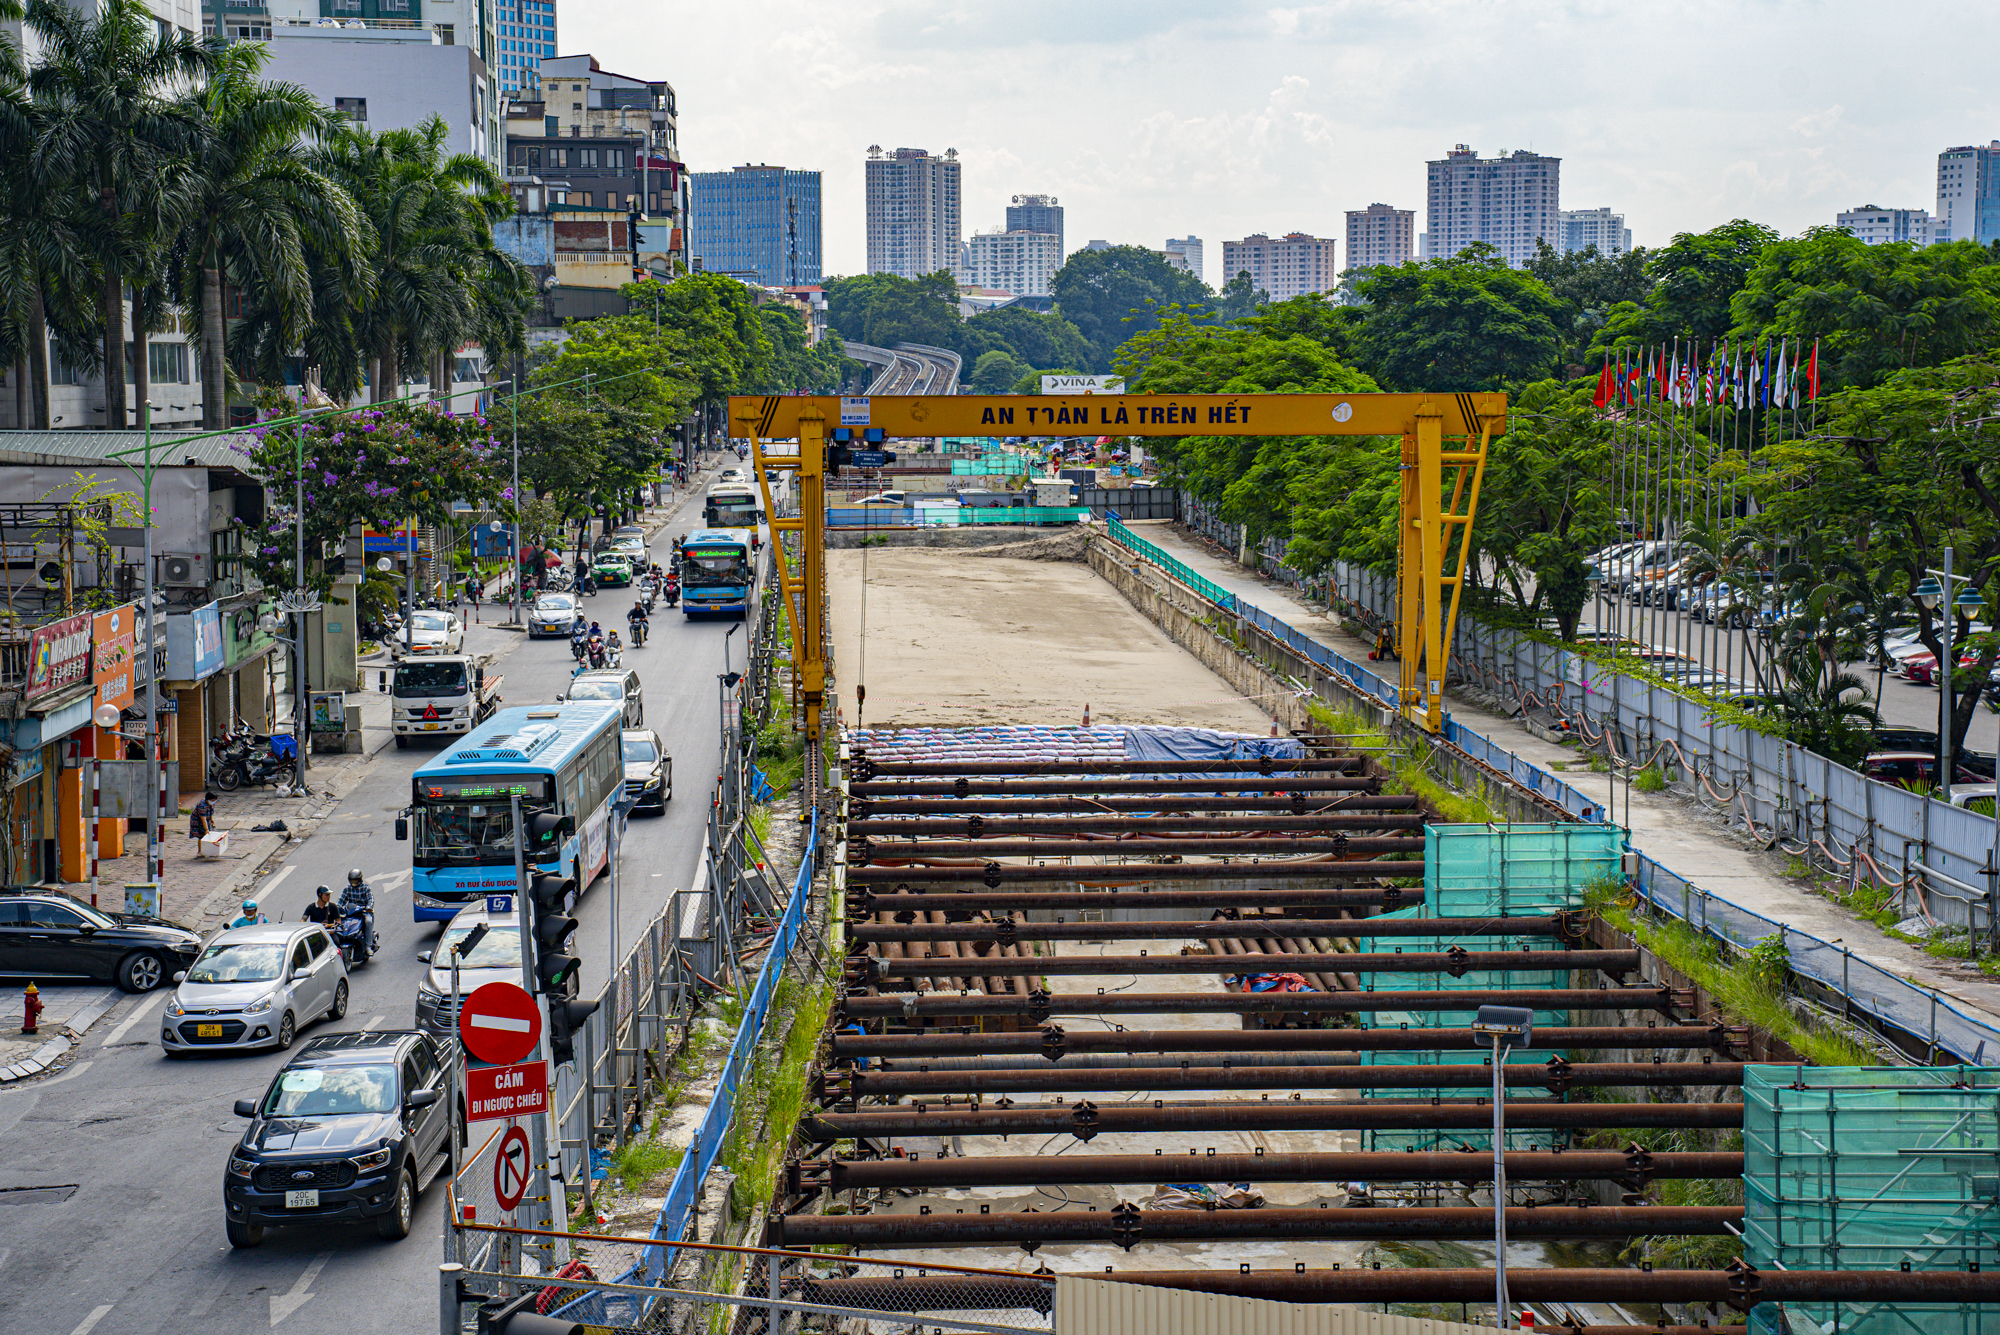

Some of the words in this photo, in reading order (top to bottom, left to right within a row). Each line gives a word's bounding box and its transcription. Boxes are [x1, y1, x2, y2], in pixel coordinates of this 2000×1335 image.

[981, 407, 1014, 424] AN
[1101, 401, 1129, 424] LÀ
[1137, 402, 1197, 424] TRÊN
[1208, 399, 1251, 424] HẾT
[493, 898, 506, 911] G7
[495, 1068, 524, 1089] CẤM
[472, 1100, 482, 1114] ĐI
[484, 1096, 514, 1112] NGƯỢC
[516, 1089, 543, 1108] CHIỀU
[290, 1198, 315, 1207] 197.65
[294, 1191, 309, 1199] 20C
